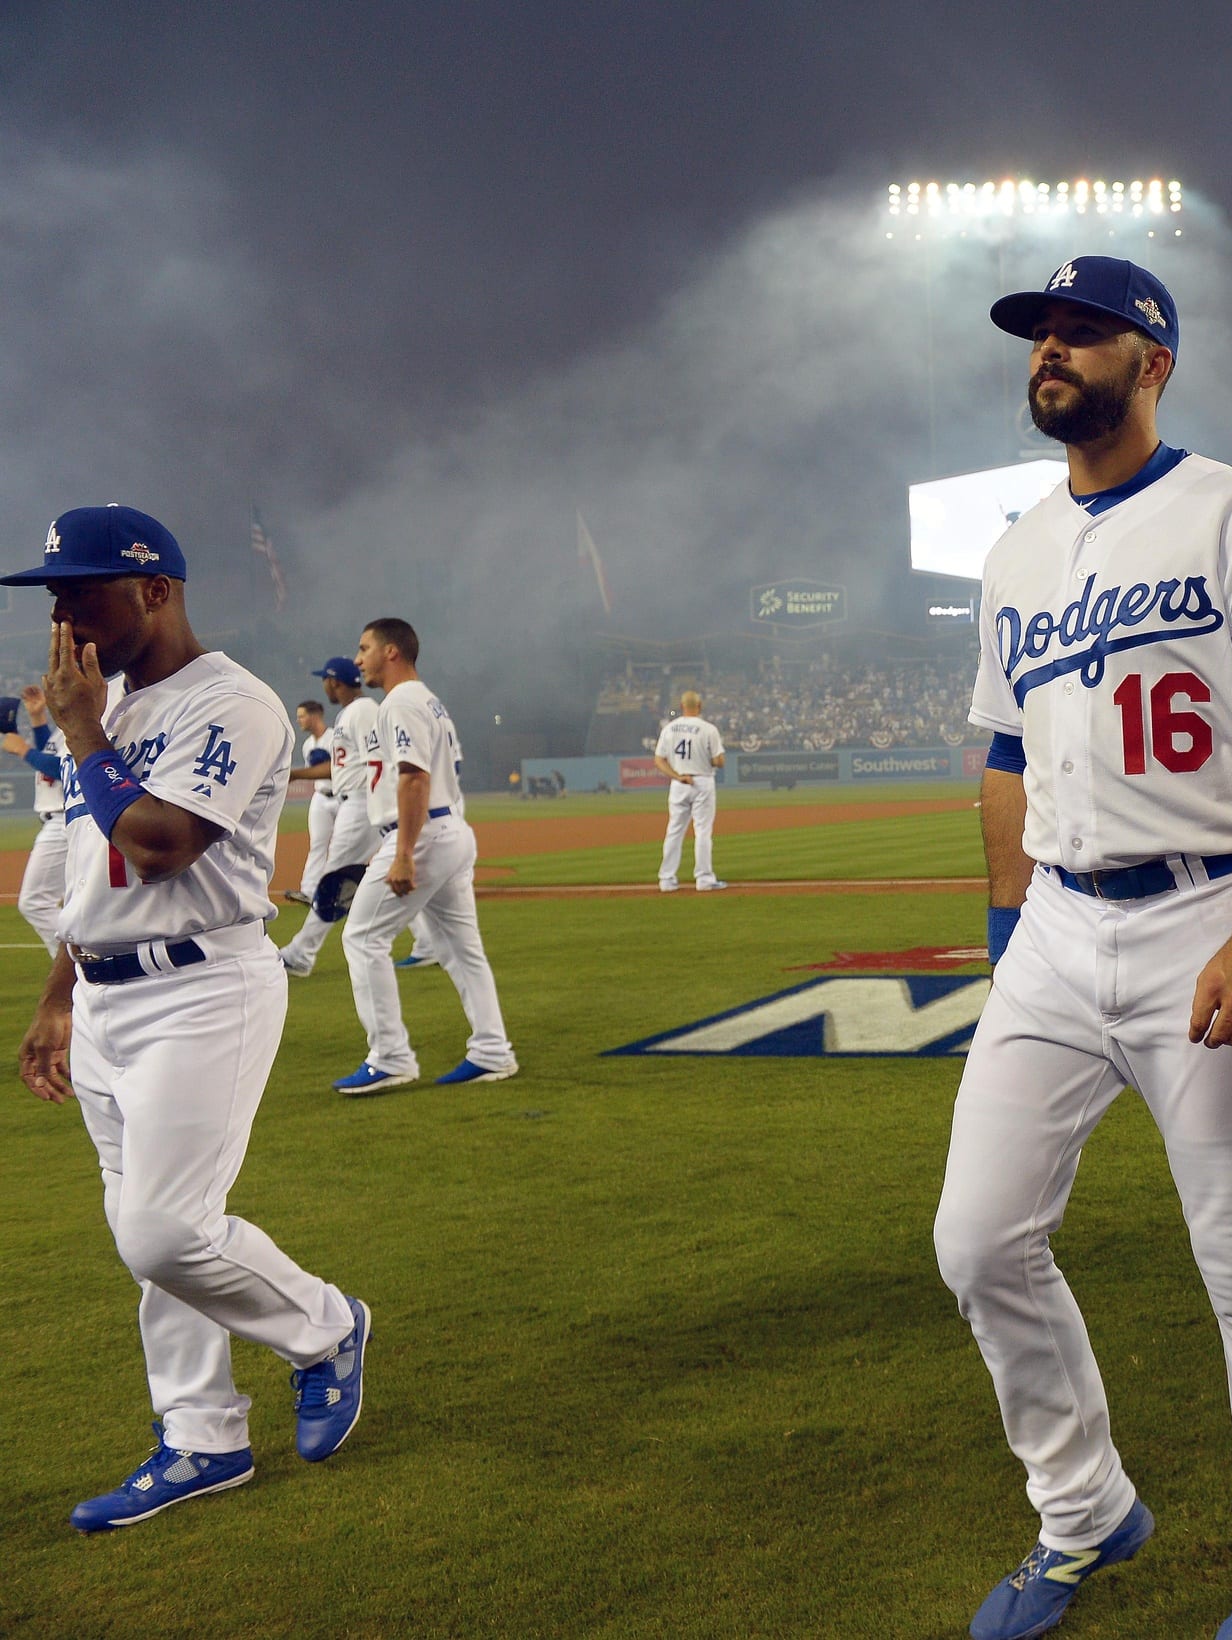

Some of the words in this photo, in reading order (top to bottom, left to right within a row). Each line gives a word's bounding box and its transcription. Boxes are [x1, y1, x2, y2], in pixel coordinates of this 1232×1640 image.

[1049, 261, 1078, 291] LA
[44, 520, 61, 554] LA
[787, 591, 840, 602] SECURITY
[787, 602, 833, 615] BENEFIT
[996, 572, 1224, 700] Dodgers
[395, 726, 411, 747] LA
[1113, 672, 1213, 776] 16
[192, 723, 238, 787] LA
[674, 738, 692, 760] 41
[367, 761, 383, 792] 7
[852, 757, 938, 774] Southwest
